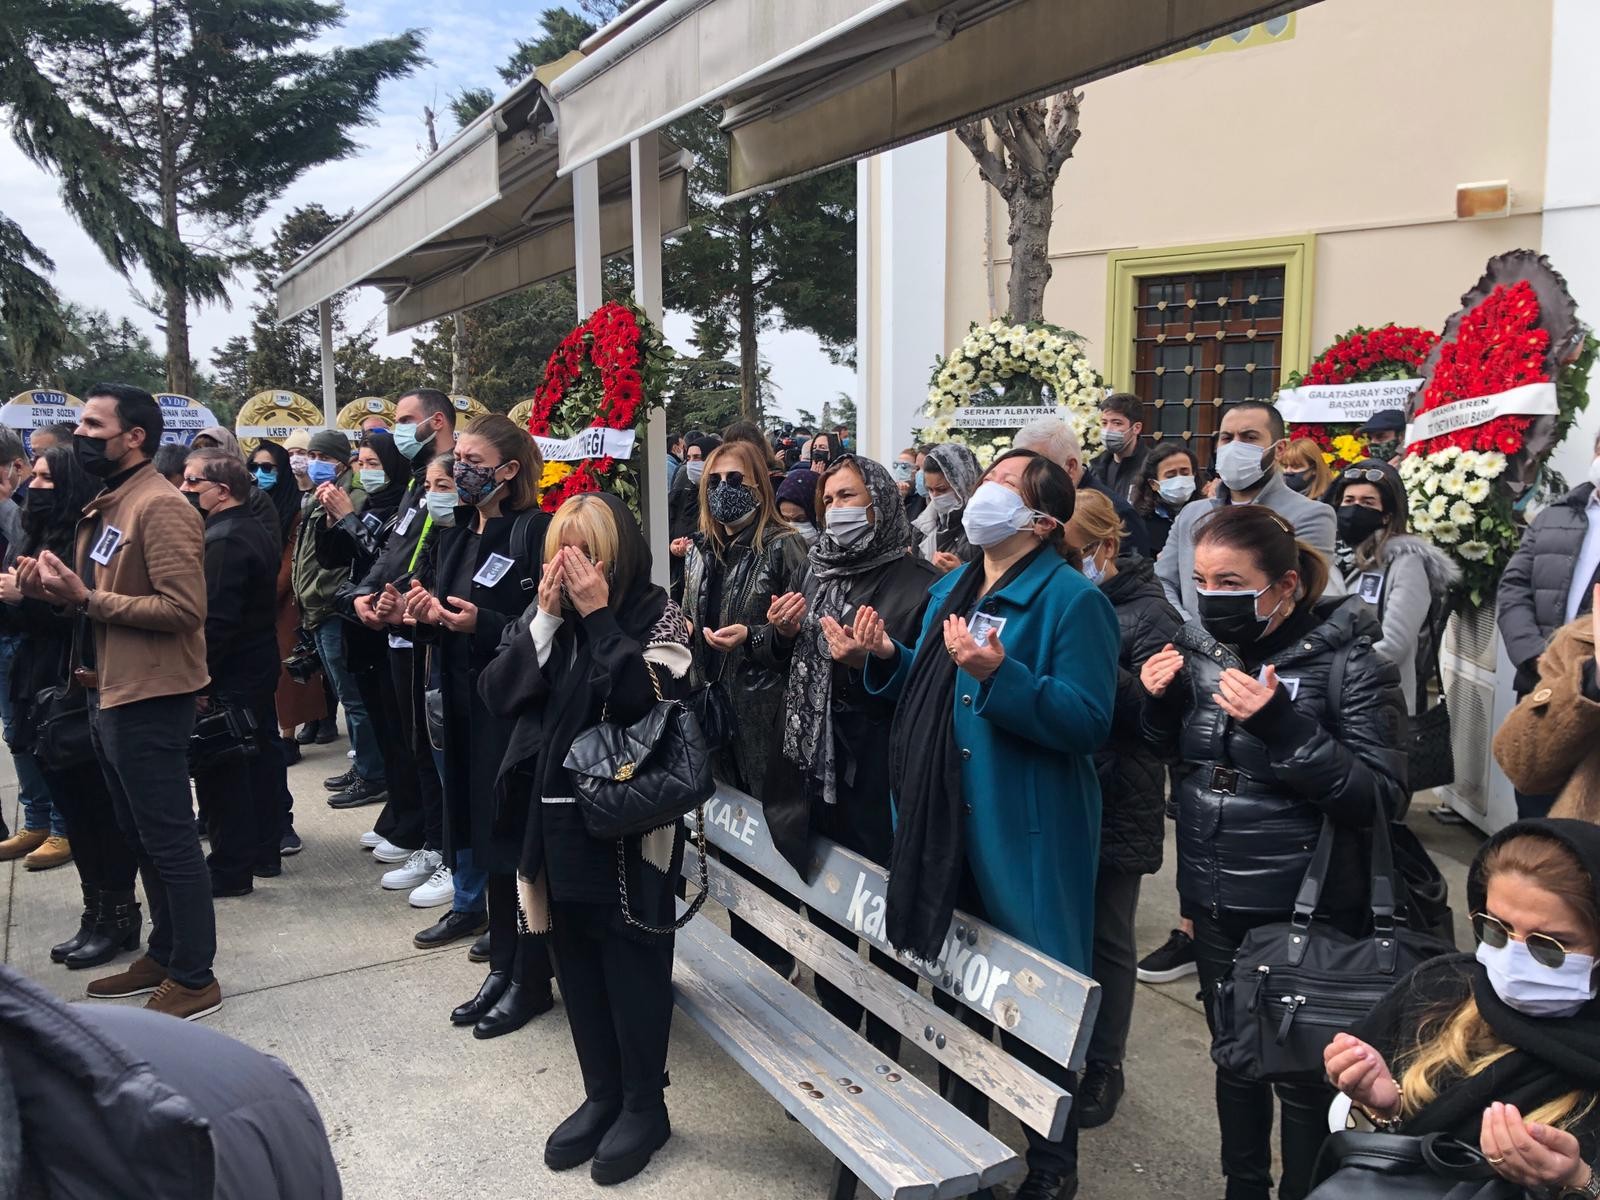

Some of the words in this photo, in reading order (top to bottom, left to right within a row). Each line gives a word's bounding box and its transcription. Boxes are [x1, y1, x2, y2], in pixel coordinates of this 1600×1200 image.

[1308, 389, 1379, 399] GALATASARAY
[1328, 399, 1369, 409] BAŞKAN
[1459, 398, 1490, 409] EREN
[31, 408, 54, 417] ZEYNEP
[1004, 407, 1056, 415] ALBAYRAK
[266, 427, 288, 436] İLKER
